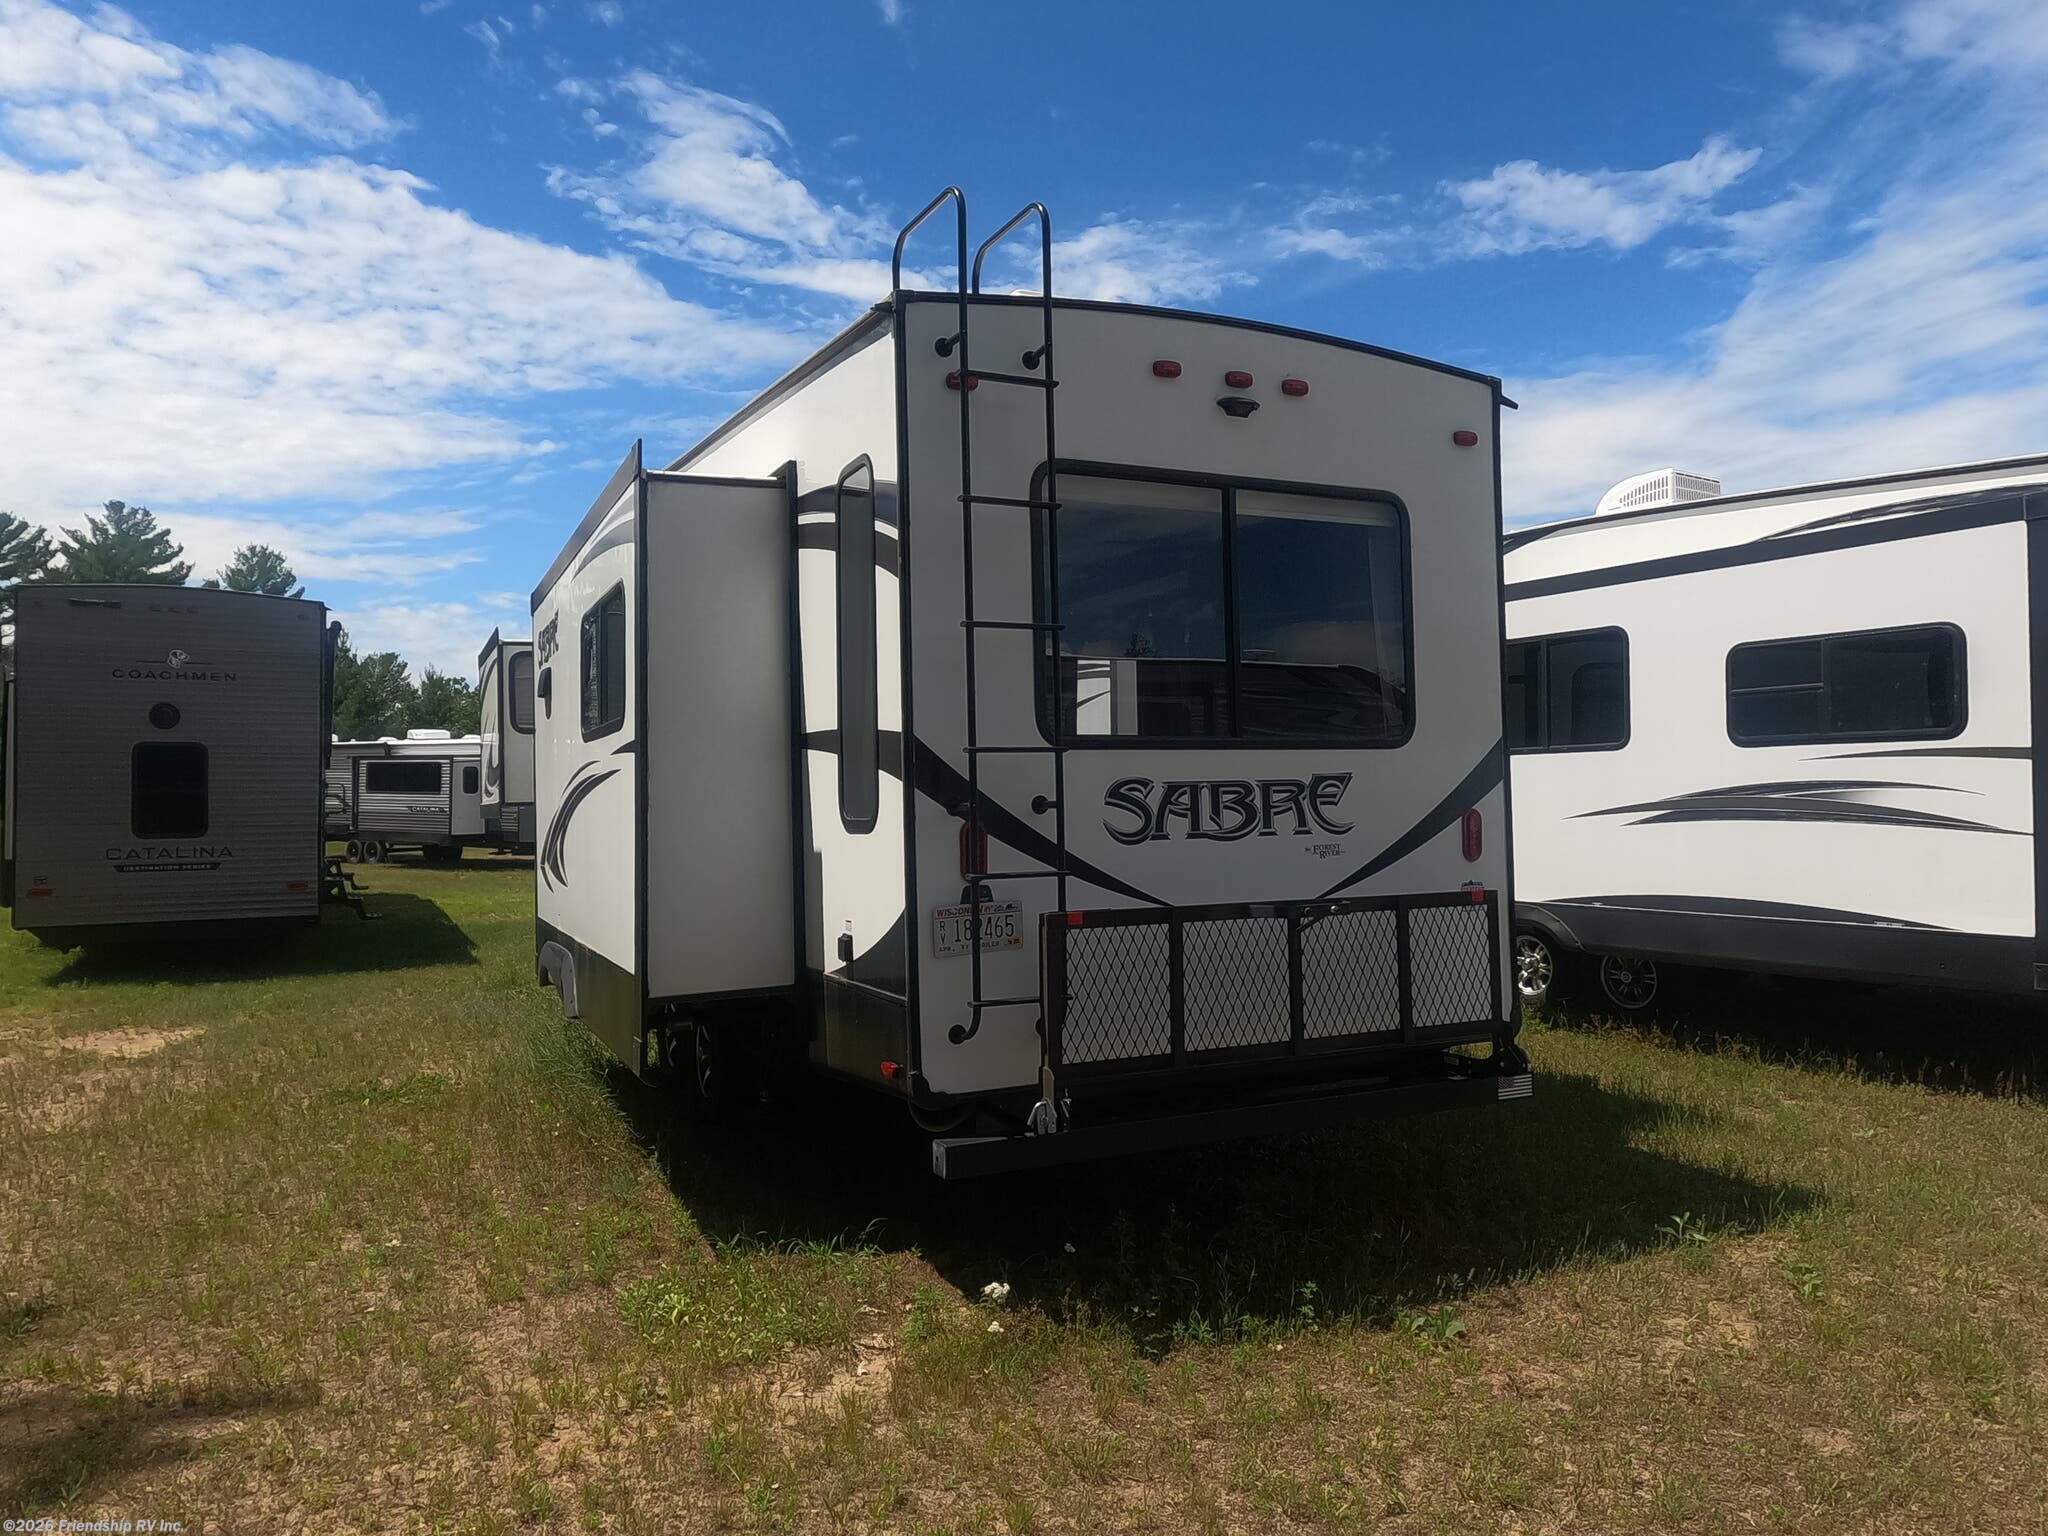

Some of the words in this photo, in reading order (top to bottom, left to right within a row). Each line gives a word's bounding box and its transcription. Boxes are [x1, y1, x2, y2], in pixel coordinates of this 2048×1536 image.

[111, 668, 238, 682] COACHMEN
[1101, 771, 1356, 847] SABRE
[105, 846, 234, 860] CATALINA
